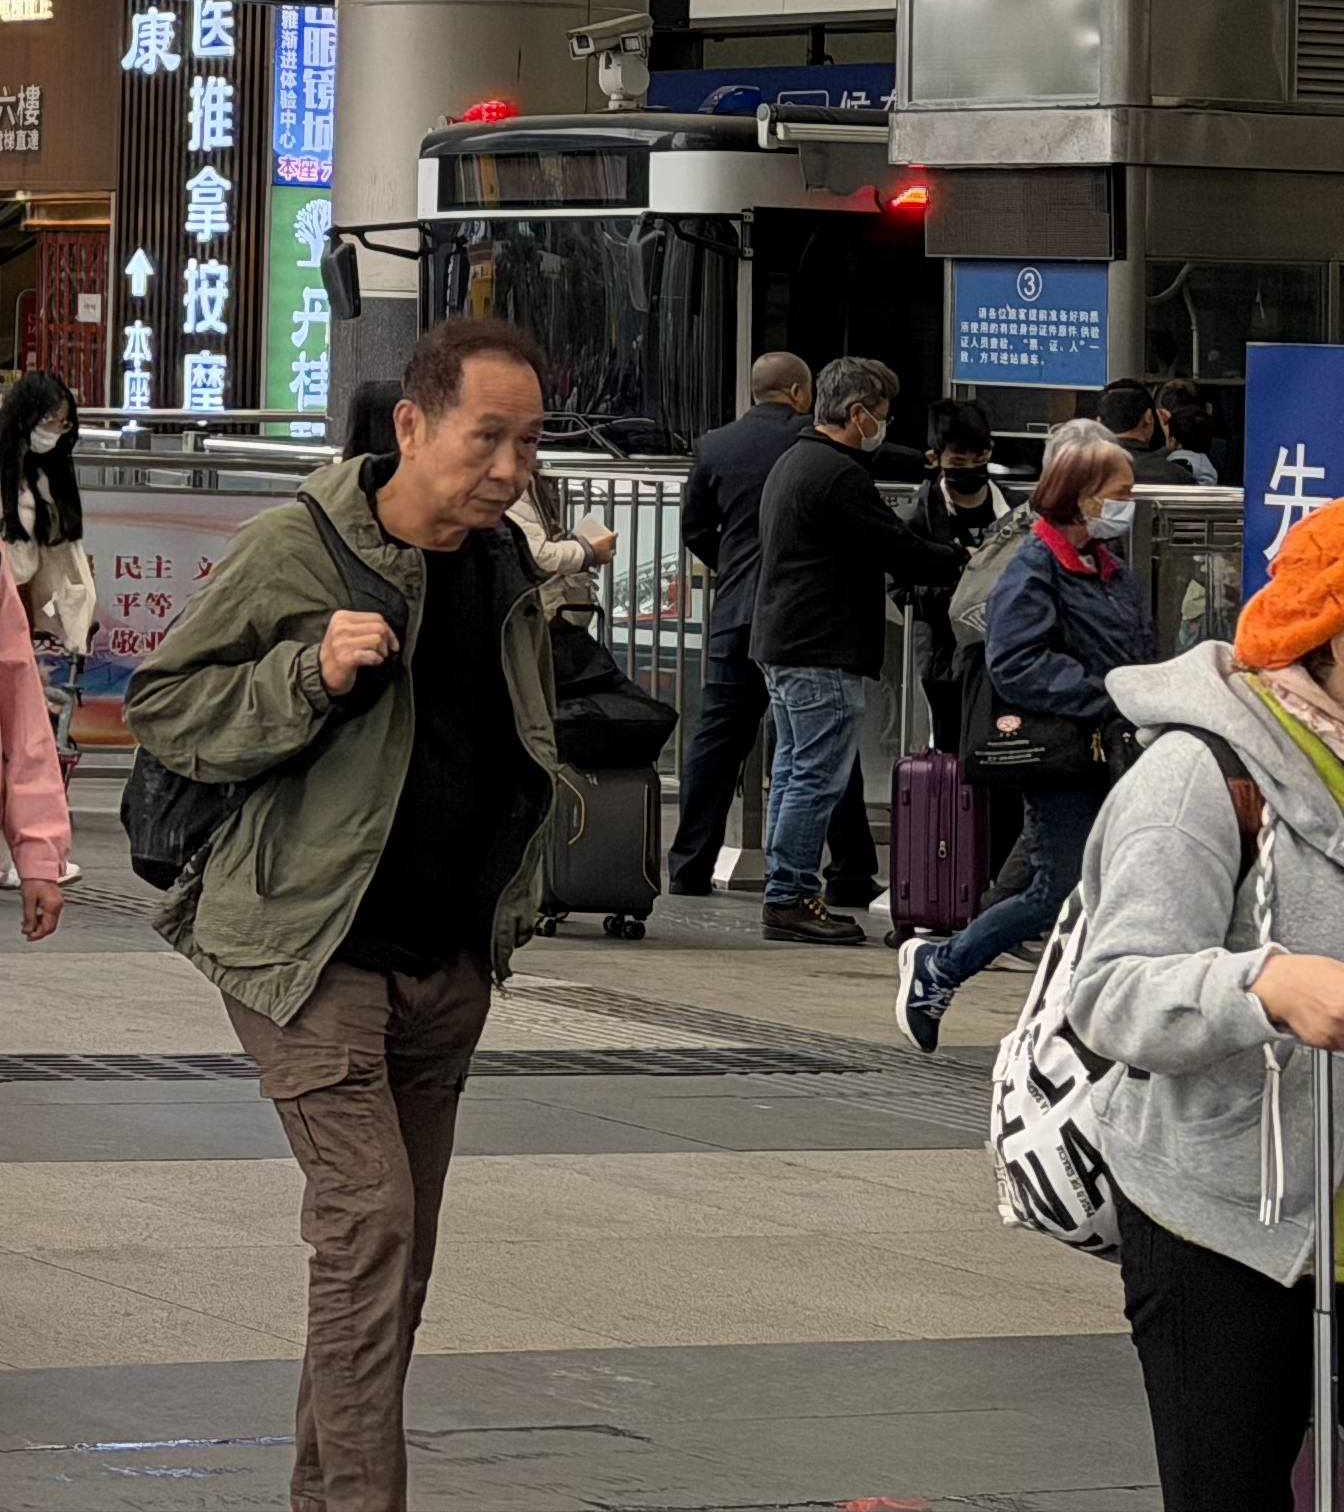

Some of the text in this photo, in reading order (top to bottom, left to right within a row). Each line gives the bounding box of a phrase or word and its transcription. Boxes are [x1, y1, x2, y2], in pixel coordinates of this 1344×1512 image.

[978, 306, 1099, 324] 请各位旅客提前准备好购票
[115, 555, 173, 580] 民主
[113, 592, 173, 618] 平等
